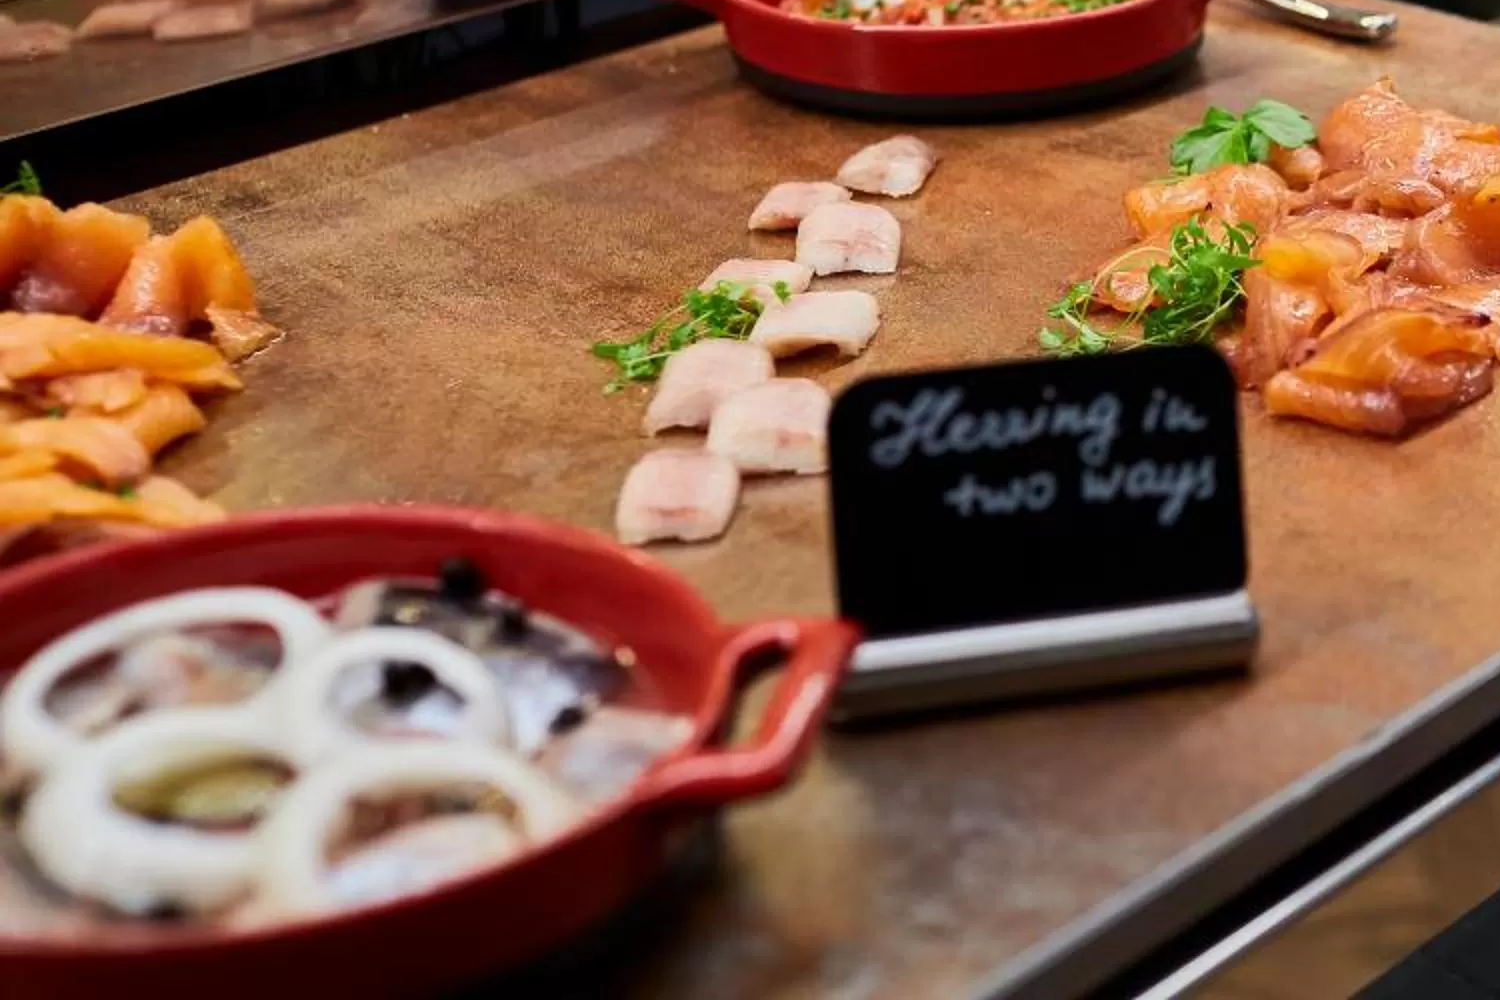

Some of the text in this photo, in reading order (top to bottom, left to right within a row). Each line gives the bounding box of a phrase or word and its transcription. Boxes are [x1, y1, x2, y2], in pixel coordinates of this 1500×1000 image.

[870, 386, 1208, 467] Herring in
[944, 456, 1216, 525] two ways
